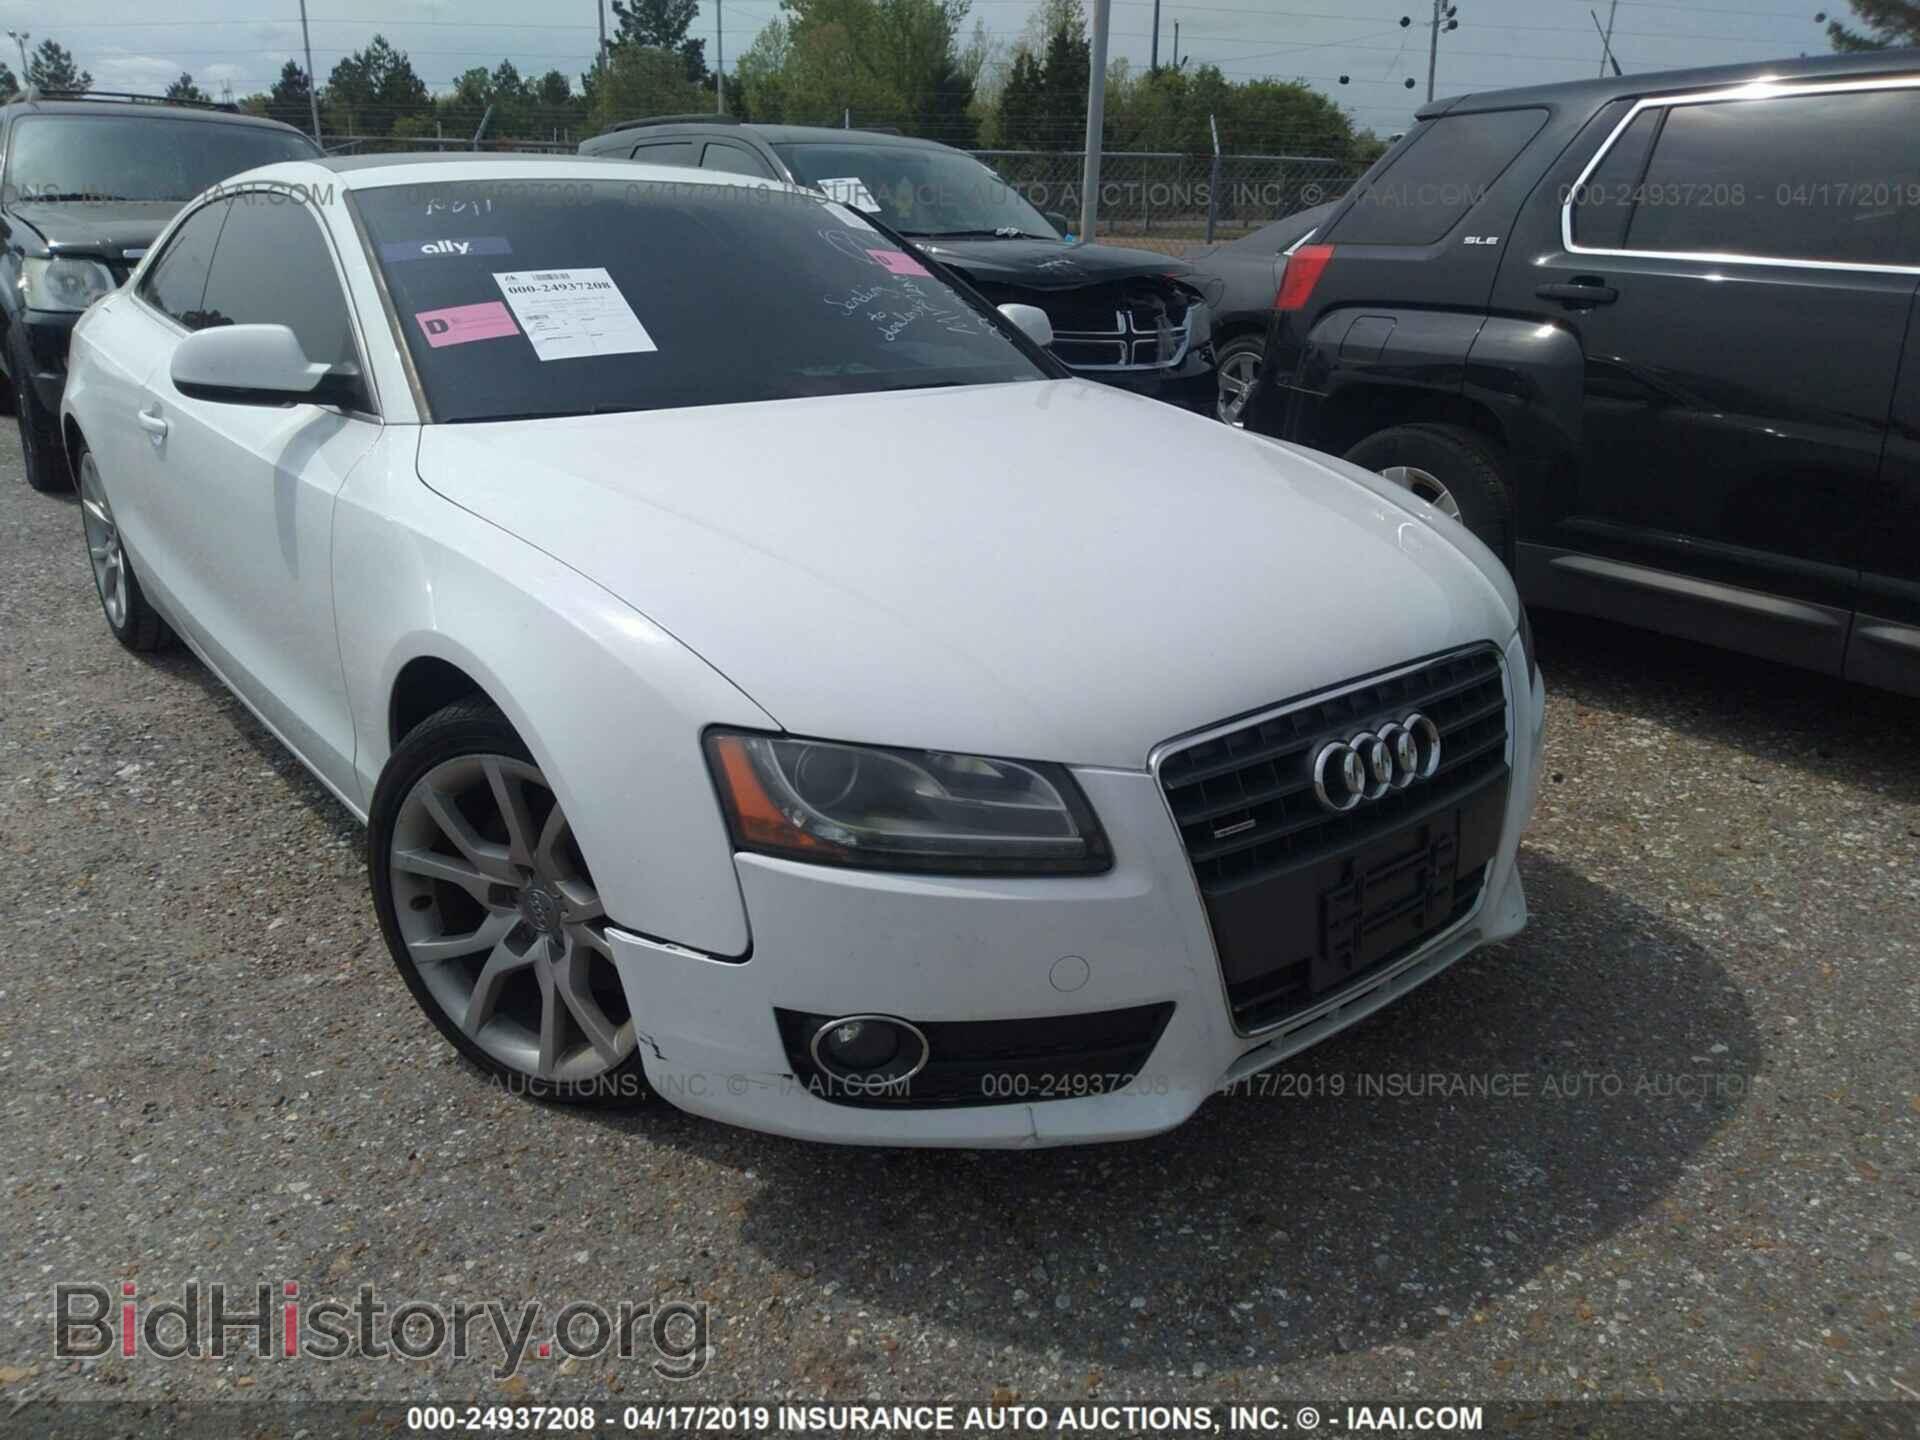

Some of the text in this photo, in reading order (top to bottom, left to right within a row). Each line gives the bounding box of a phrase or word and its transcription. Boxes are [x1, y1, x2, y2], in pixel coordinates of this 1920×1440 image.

[421, 240, 470, 254] ally
[1464, 236, 1498, 245] SLE
[508, 281, 611, 295] 000-24937208
